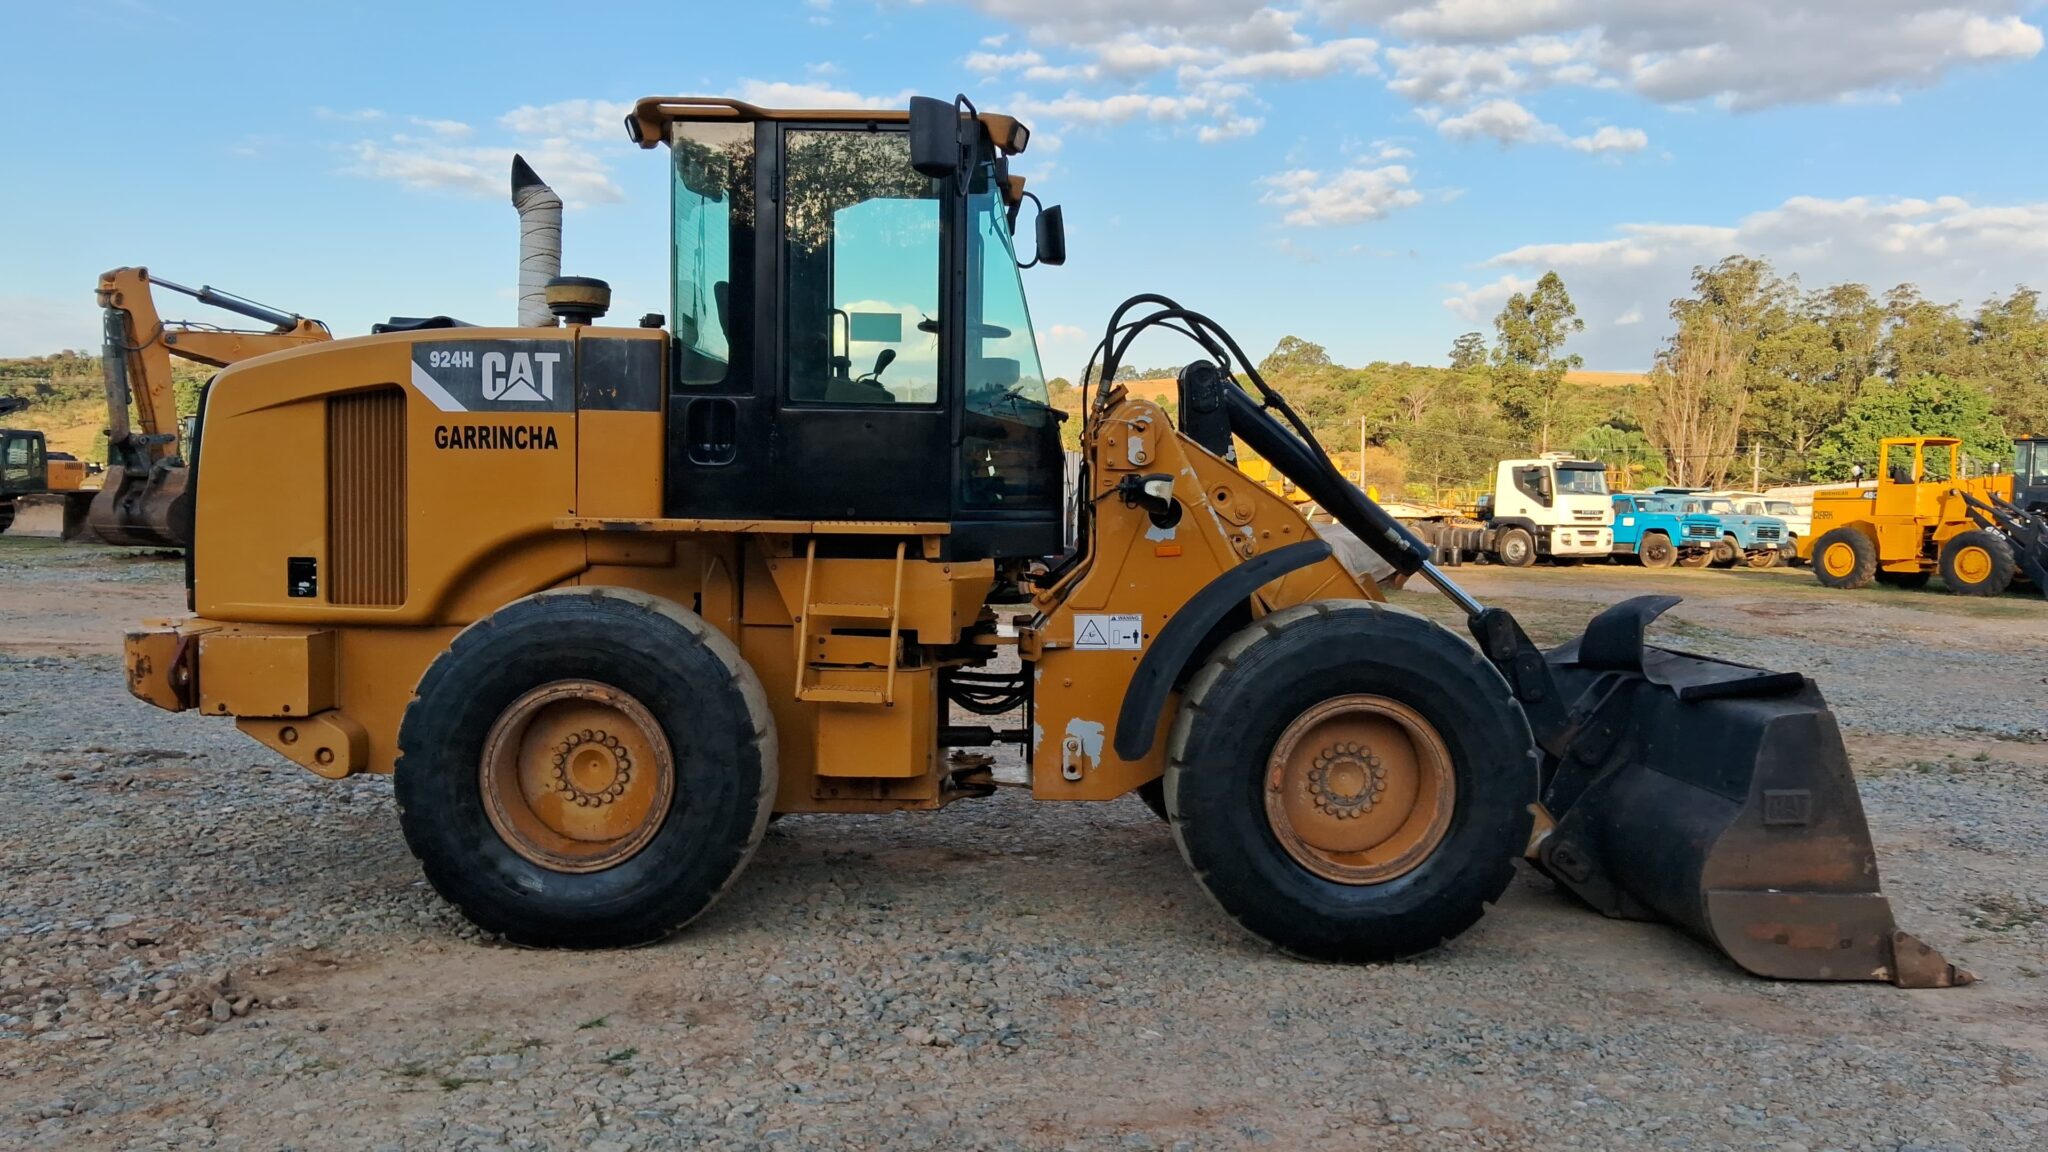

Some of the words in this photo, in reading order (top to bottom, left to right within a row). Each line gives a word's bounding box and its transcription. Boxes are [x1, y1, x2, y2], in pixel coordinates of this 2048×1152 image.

[430, 350, 474, 368] 924H
[481, 352, 561, 401] CAT
[434, 425, 559, 450] GARRINCHA
